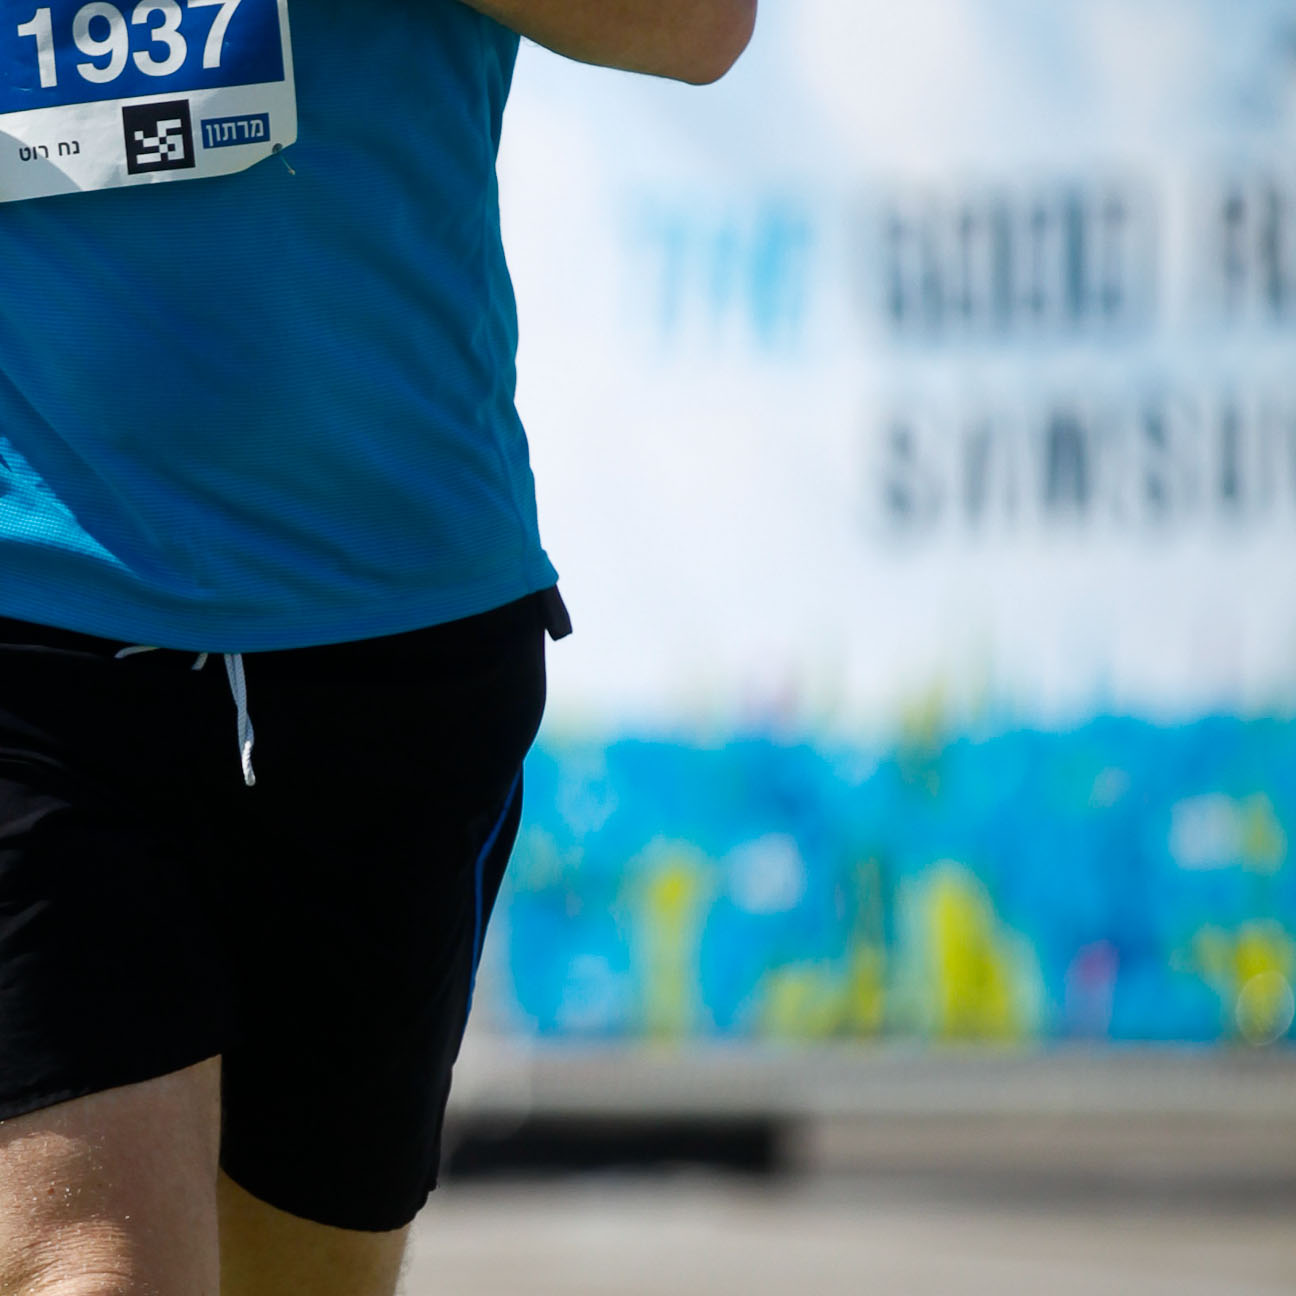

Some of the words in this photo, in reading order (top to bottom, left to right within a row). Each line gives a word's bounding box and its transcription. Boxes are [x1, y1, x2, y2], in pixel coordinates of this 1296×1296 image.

[205, 119, 264, 147] מרתון
[19, 145, 49, 162] רוט
[57, 140, 80, 156] נח
